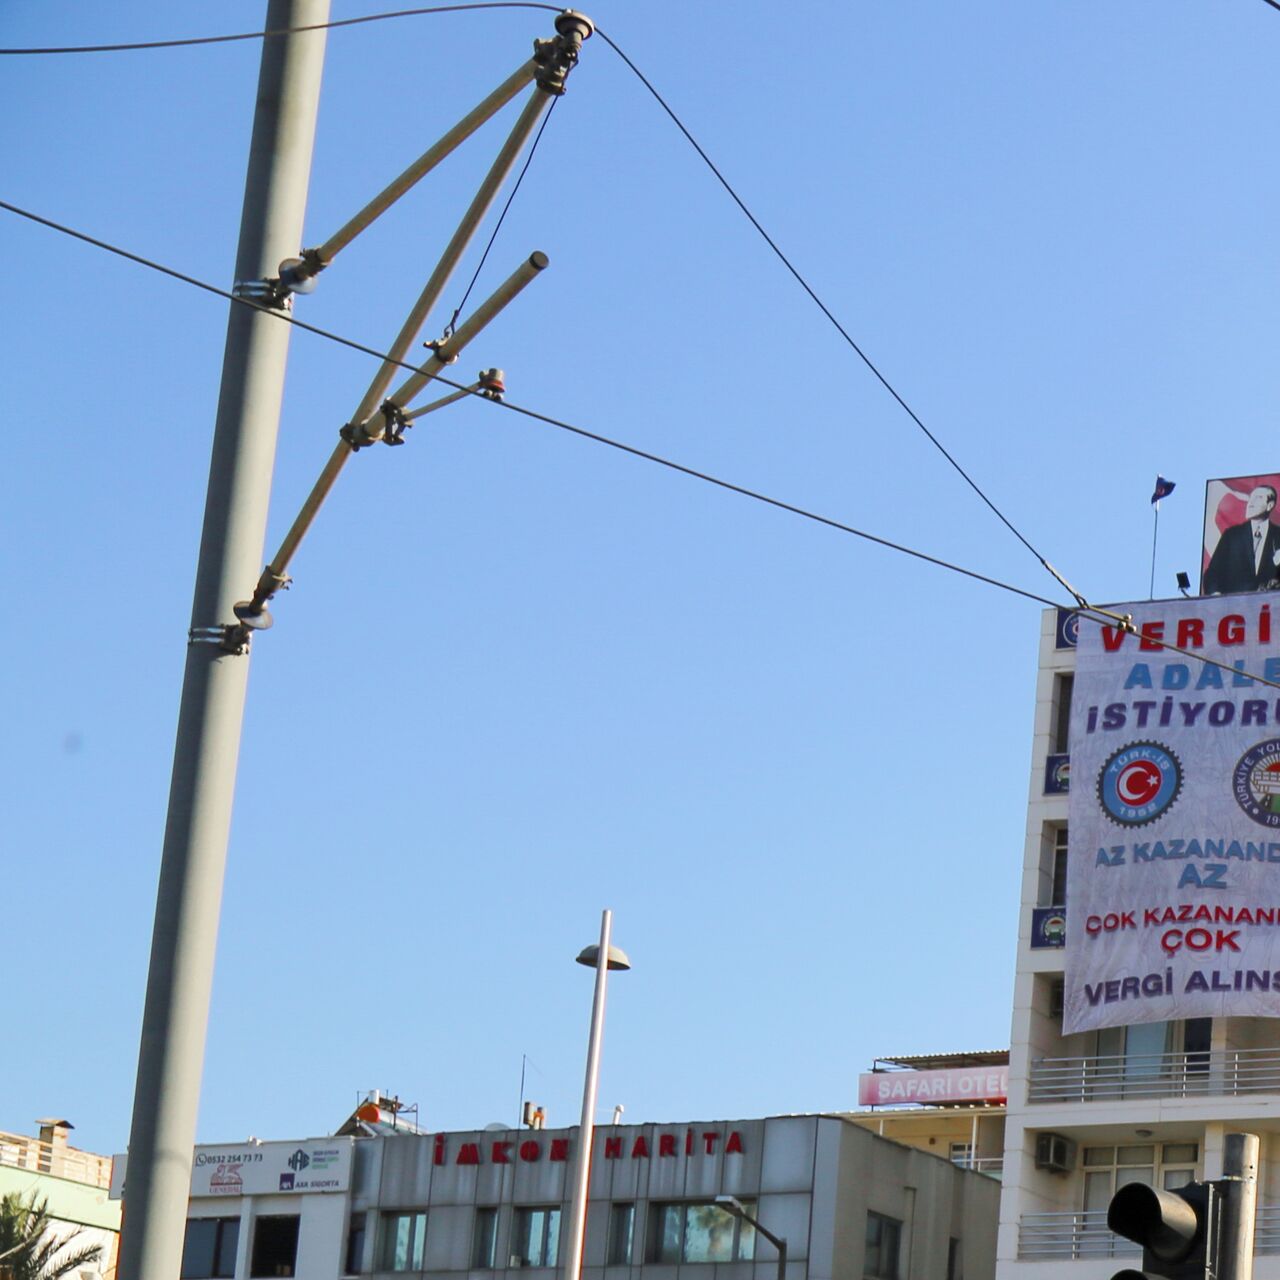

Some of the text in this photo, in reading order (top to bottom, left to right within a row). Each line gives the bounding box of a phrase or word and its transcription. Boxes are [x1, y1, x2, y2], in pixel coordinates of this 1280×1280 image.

[1096, 846, 1126, 868] AZ
[1177, 863, 1228, 890] AZ
[1085, 911, 1138, 941] ÇOK
[1161, 927, 1242, 959] ÇOK
[1084, 966, 1174, 1007] VERGİ
[958, 1072, 1009, 1094] OTEL
[207, 1154, 225, 1164] 0532
[227, 1154, 241, 1163] 254
[254, 1153, 263, 1162] 73
[434, 1128, 743, 1165] İMKON HARİTA
